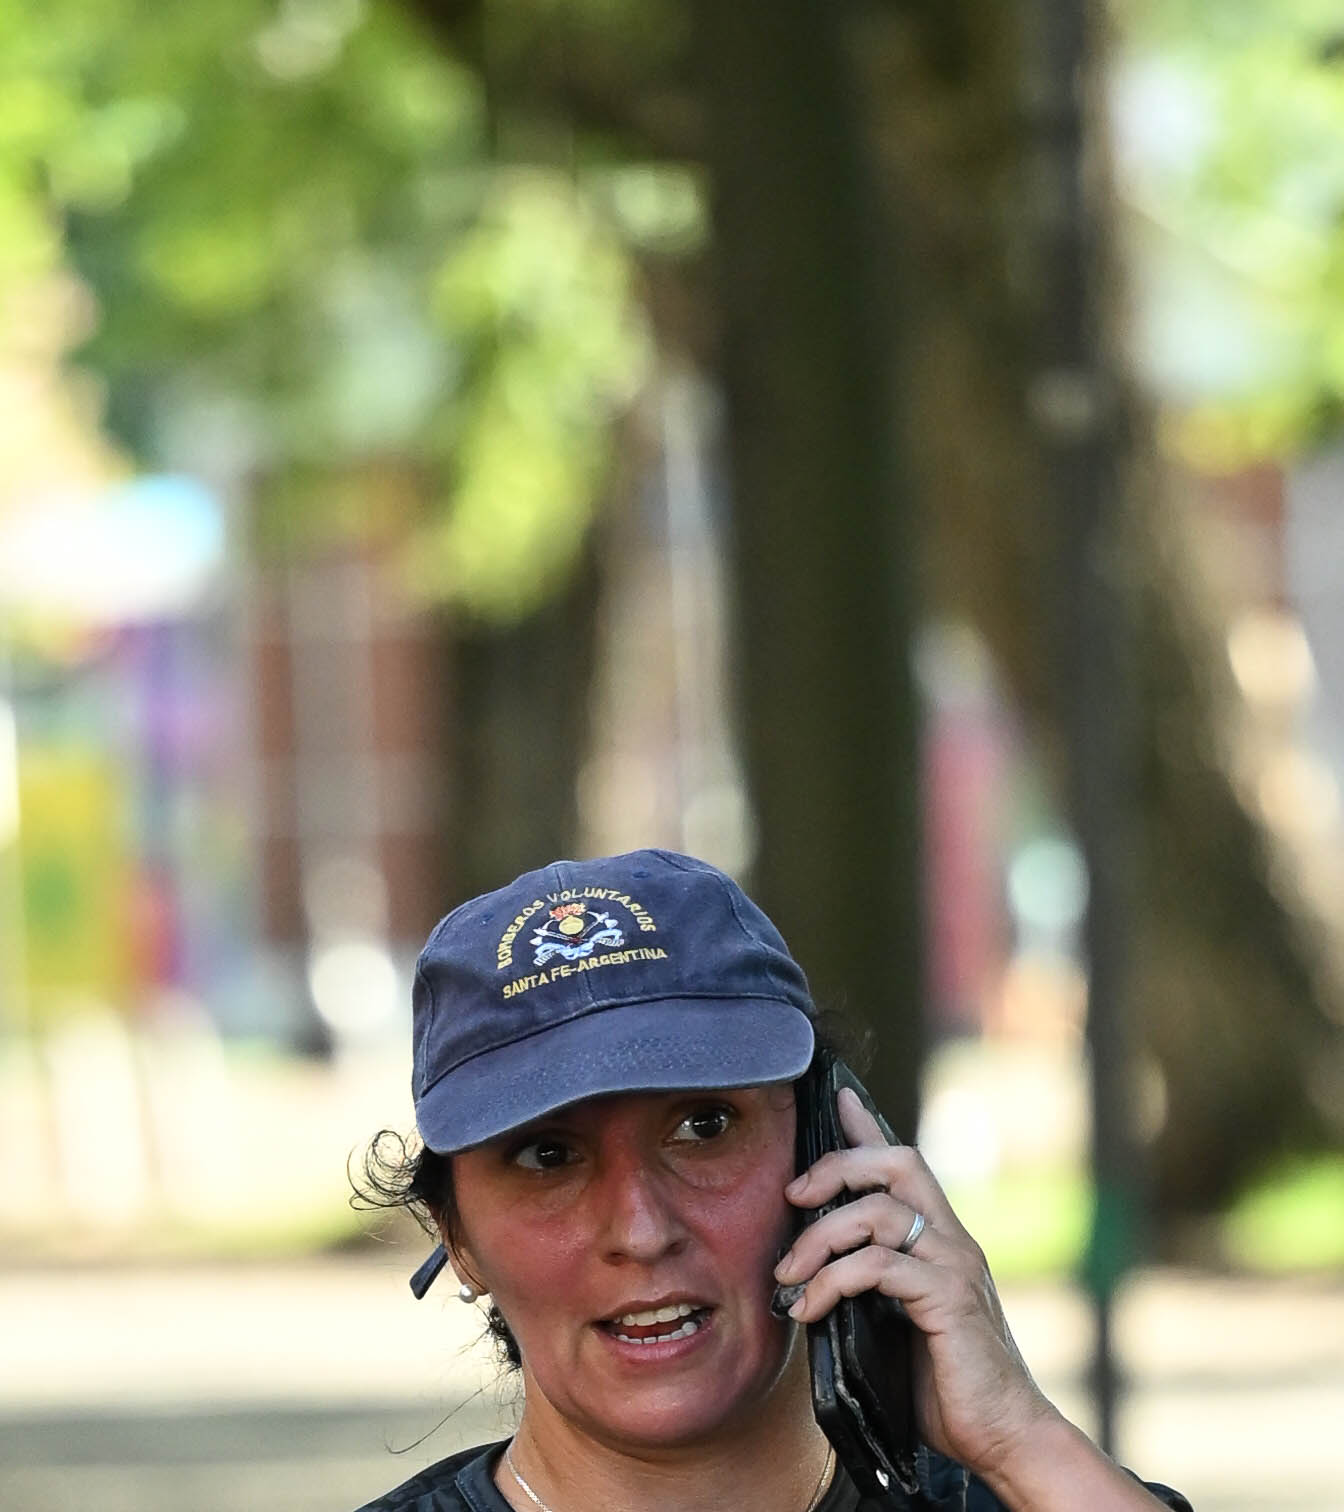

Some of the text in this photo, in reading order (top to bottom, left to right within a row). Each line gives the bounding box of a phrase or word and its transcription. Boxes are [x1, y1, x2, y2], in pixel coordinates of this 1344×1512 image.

[497, 886, 657, 970] BOMBEROS VOLUNTARIOS
[502, 975, 549, 999] SANTA
